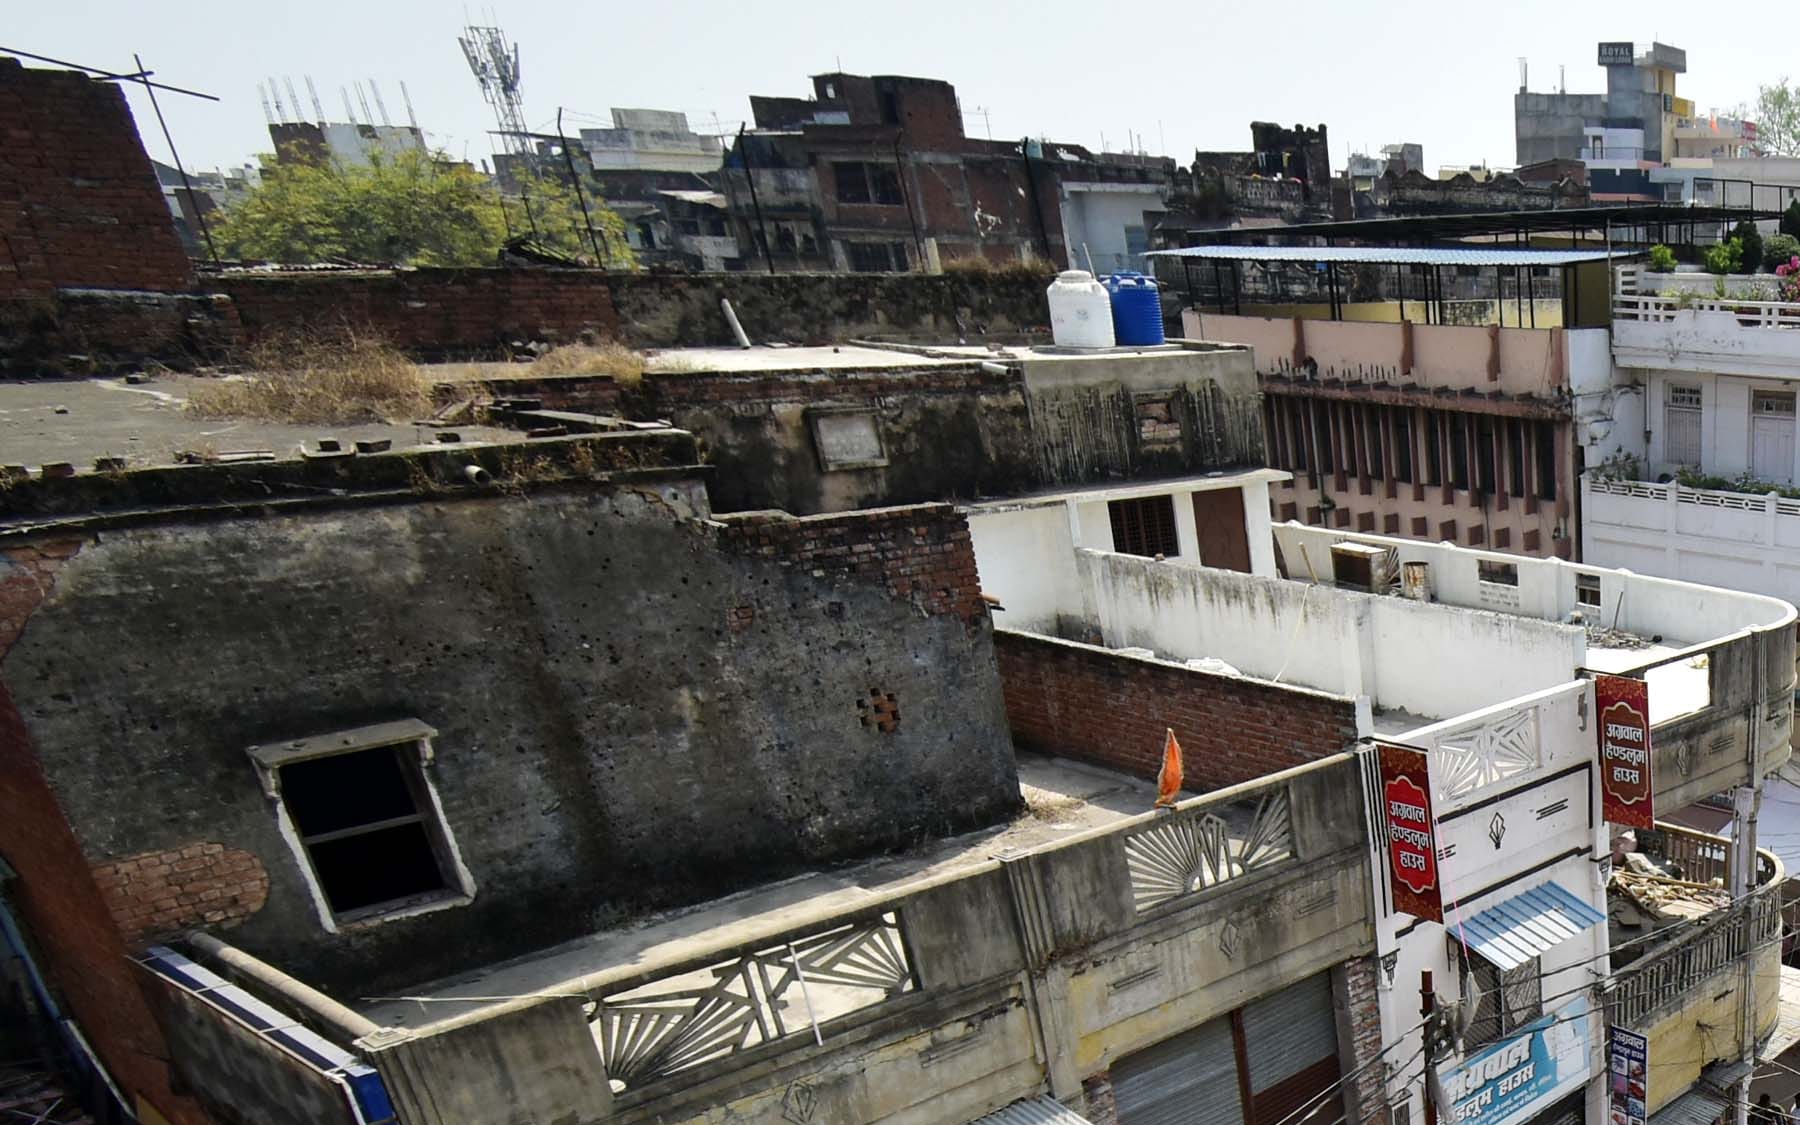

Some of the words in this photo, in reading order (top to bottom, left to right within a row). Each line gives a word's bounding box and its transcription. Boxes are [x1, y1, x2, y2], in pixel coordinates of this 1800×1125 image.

[1605, 722, 1643, 744] अग्रवाल
[1612, 764, 1640, 785] हाउस
[1389, 799, 1426, 825] अग्रवाल
[1399, 850, 1426, 872] हाउस
